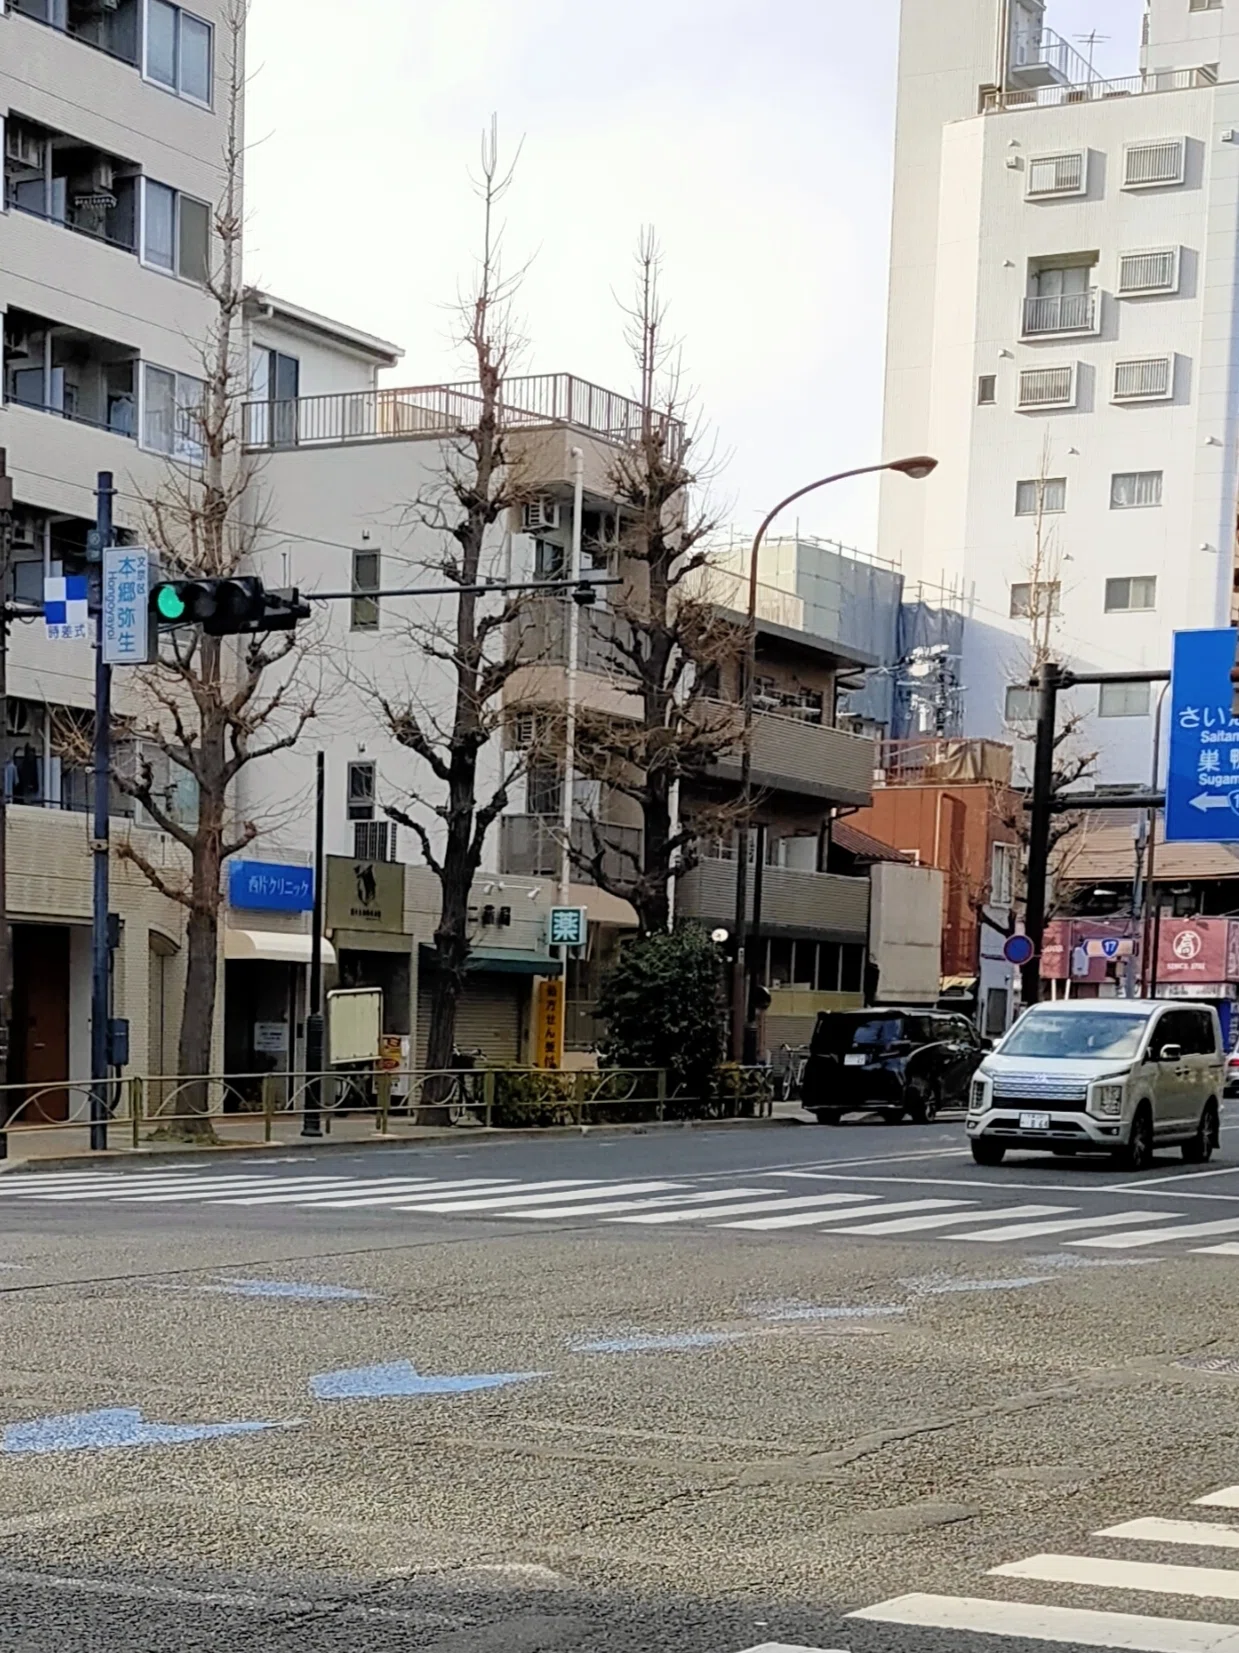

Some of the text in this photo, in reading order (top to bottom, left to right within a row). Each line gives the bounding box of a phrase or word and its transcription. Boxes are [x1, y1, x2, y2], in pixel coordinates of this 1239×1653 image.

[105, 571, 117, 640] Hongoyayoi
[118, 556, 136, 652] 本郷弥生
[553, 911, 579, 941] 薬
[1104, 941, 1117, 954] 17
